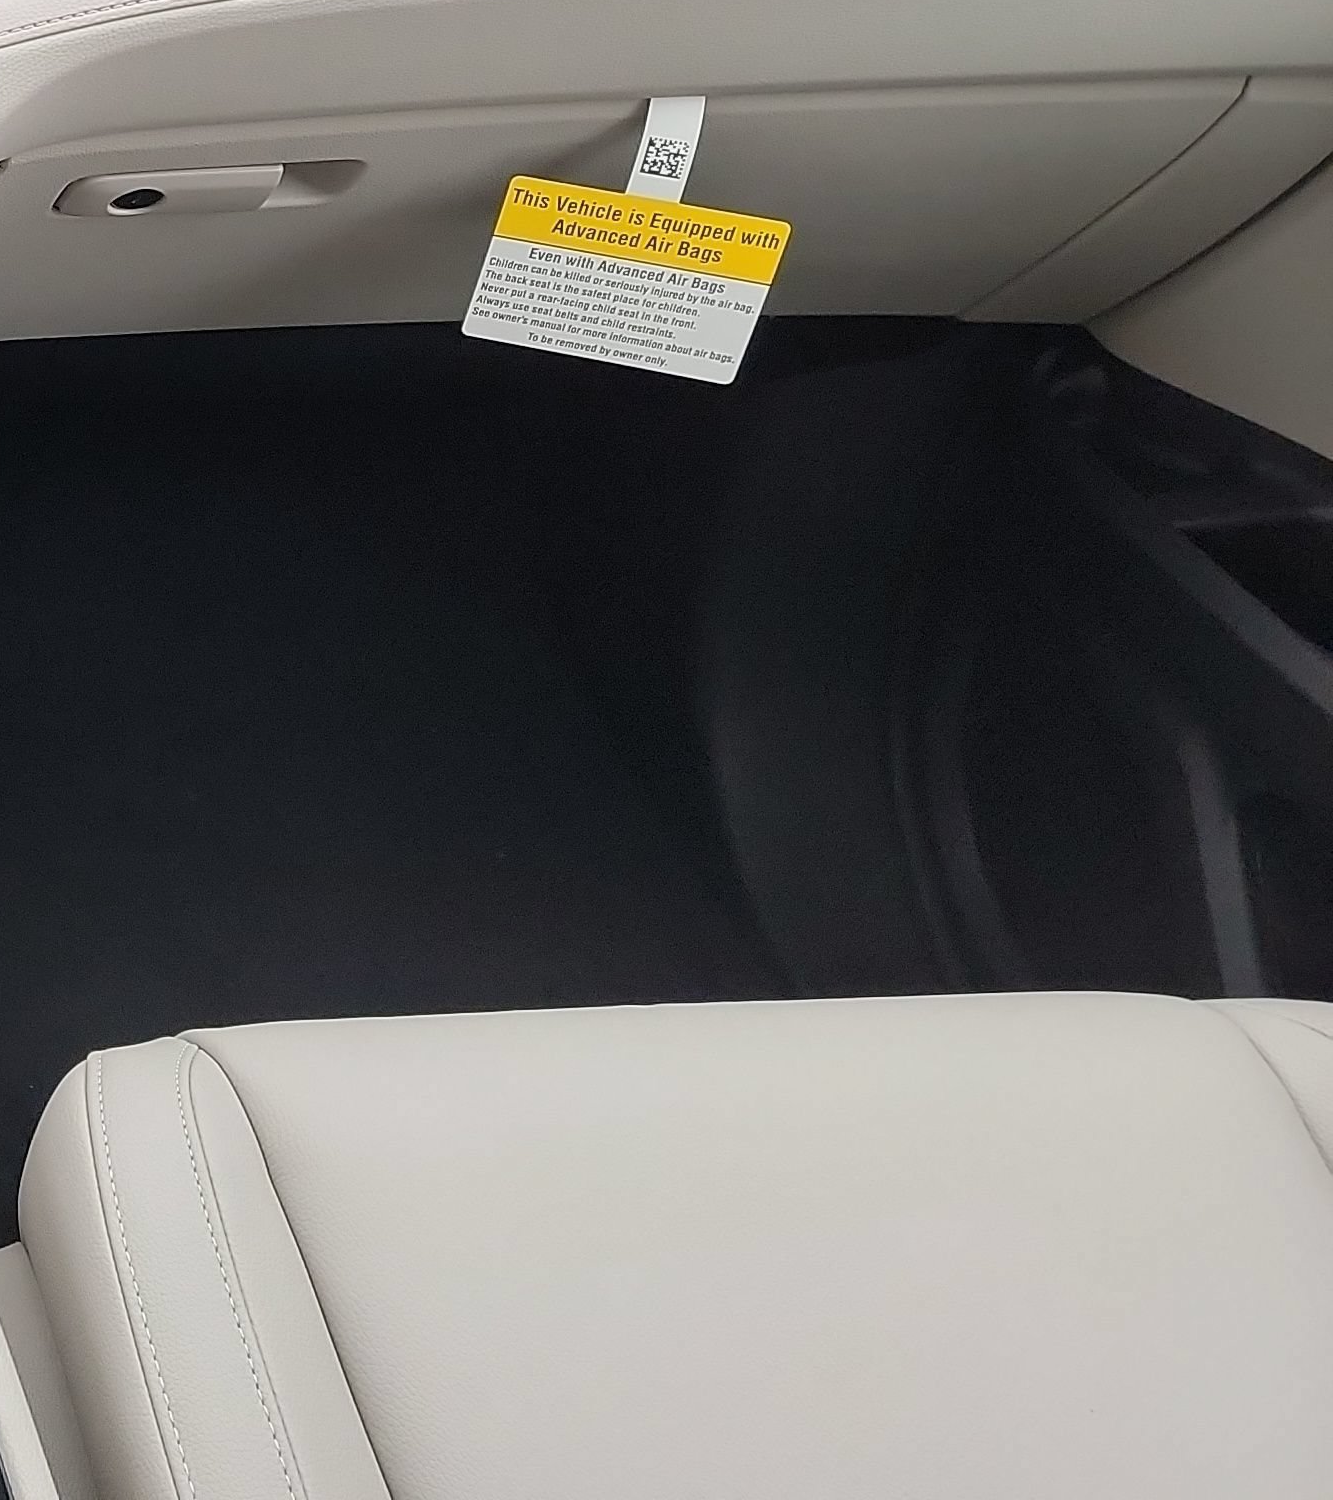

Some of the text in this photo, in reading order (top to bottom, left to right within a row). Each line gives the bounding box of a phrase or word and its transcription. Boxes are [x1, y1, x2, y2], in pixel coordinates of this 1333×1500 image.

[513, 188, 780, 250] This Vehicle is Equipped with
[551, 219, 723, 264] Advanced Air Bags
[485, 270, 701, 317] The back seat the safest place children.
[489, 257, 755, 314] Children can be killed seriously injured bag.
[529, 248, 726, 295] Even with Advanced Air Bags
[475, 295, 677, 340] Always seat belts and child restraints.
[481, 283, 697, 330] Never rear-facing child seat the front.
[471, 306, 735, 364] See owner's manual more information about bags.
[555, 338, 668, 368] removed owner only.
